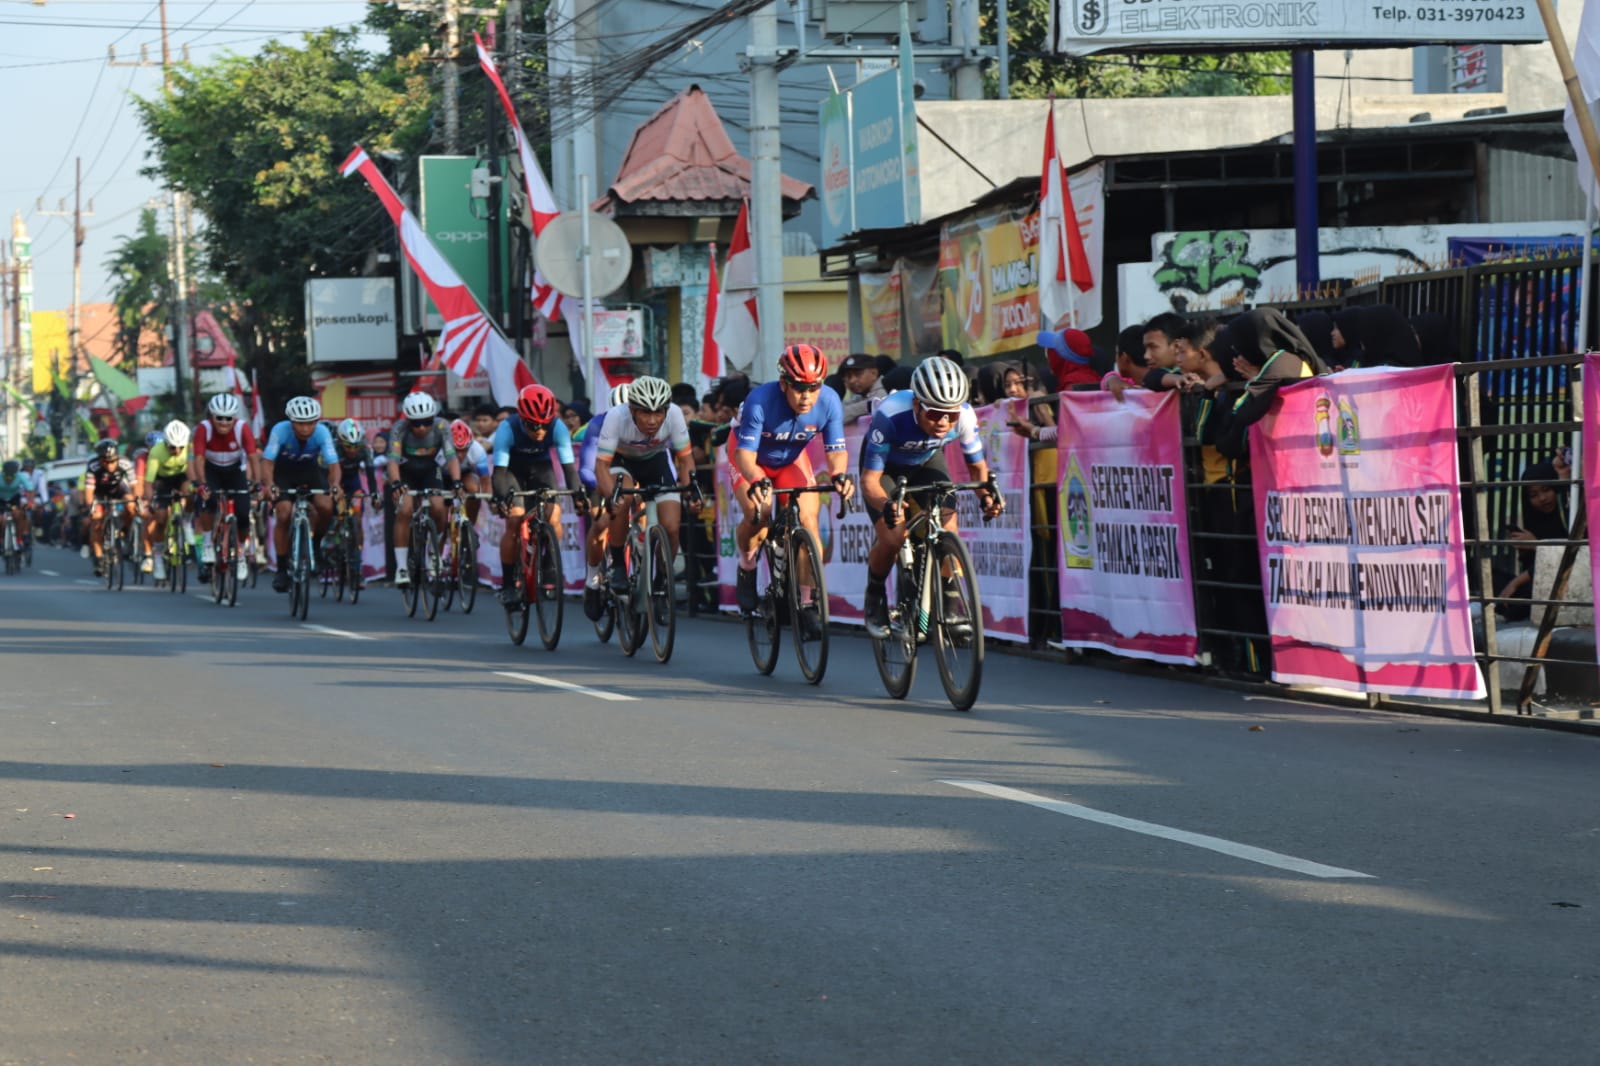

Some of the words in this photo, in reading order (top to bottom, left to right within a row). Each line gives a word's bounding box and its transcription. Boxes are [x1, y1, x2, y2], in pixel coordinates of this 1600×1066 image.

[1120, 1, 1318, 34] ELEKTRONIK
[1372, 6, 1412, 21] Telp.
[1416, 6, 1525, 22] 031-3970423
[1091, 465, 1174, 512] SEKRETARIAT
[1304, 497, 1353, 545] BERSAMA
[1353, 495, 1416, 545] MENJADI
[1415, 495, 1450, 545] SATU
[1096, 522, 1141, 575] PEMKAB
[1140, 523, 1184, 579] GRESIK
[1268, 558, 1292, 603] TAK
[1325, 561, 1347, 609] AKU
[1348, 562, 1447, 614] MENDUKUNGMU
